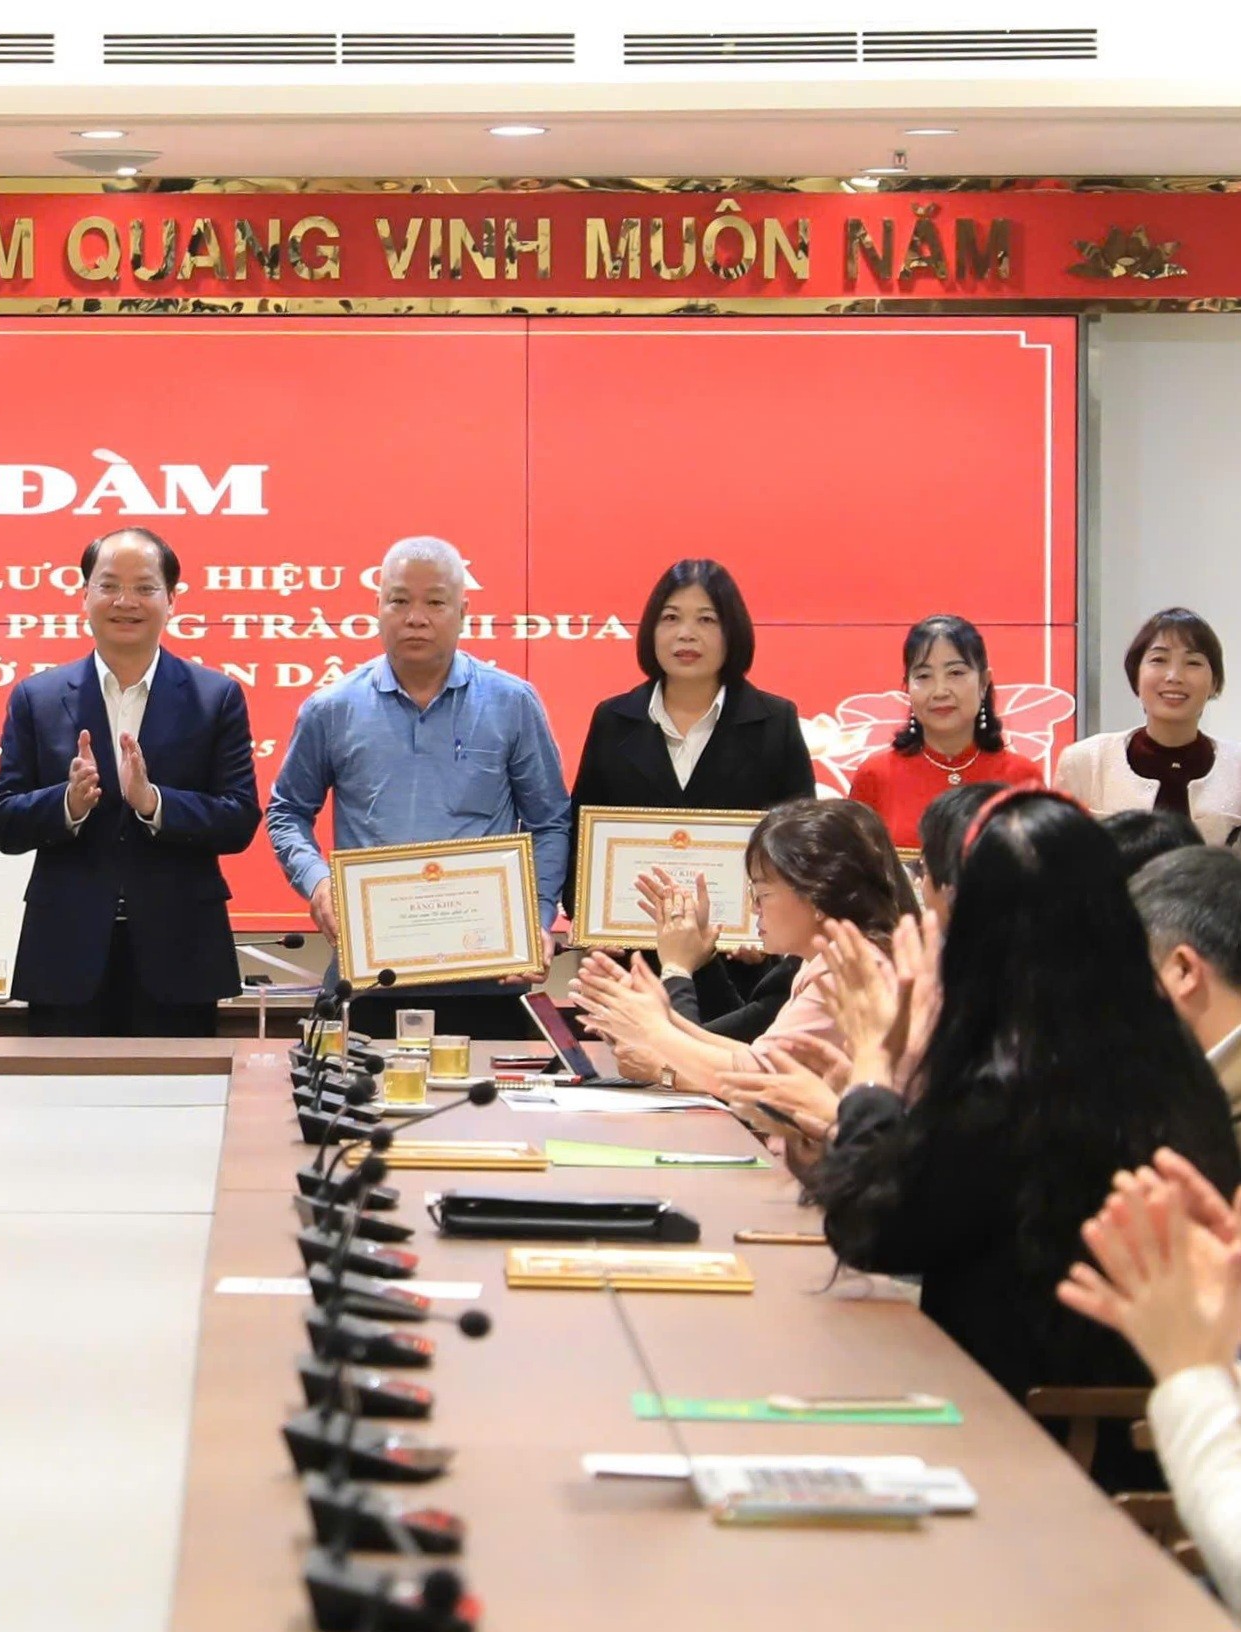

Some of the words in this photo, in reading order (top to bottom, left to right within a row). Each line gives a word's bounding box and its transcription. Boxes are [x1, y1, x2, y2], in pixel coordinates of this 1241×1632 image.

[66, 215, 341, 281] QUANG
[375, 217, 552, 280] VINH
[585, 198, 810, 280] MUÔN
[845, 202, 1011, 280] NĂM
[204, 562, 345, 597] HIỆU
[5, 613, 208, 639] PHG
[222, 607, 380, 639] TRÀO
[512, 614, 633, 640] ĐUA
